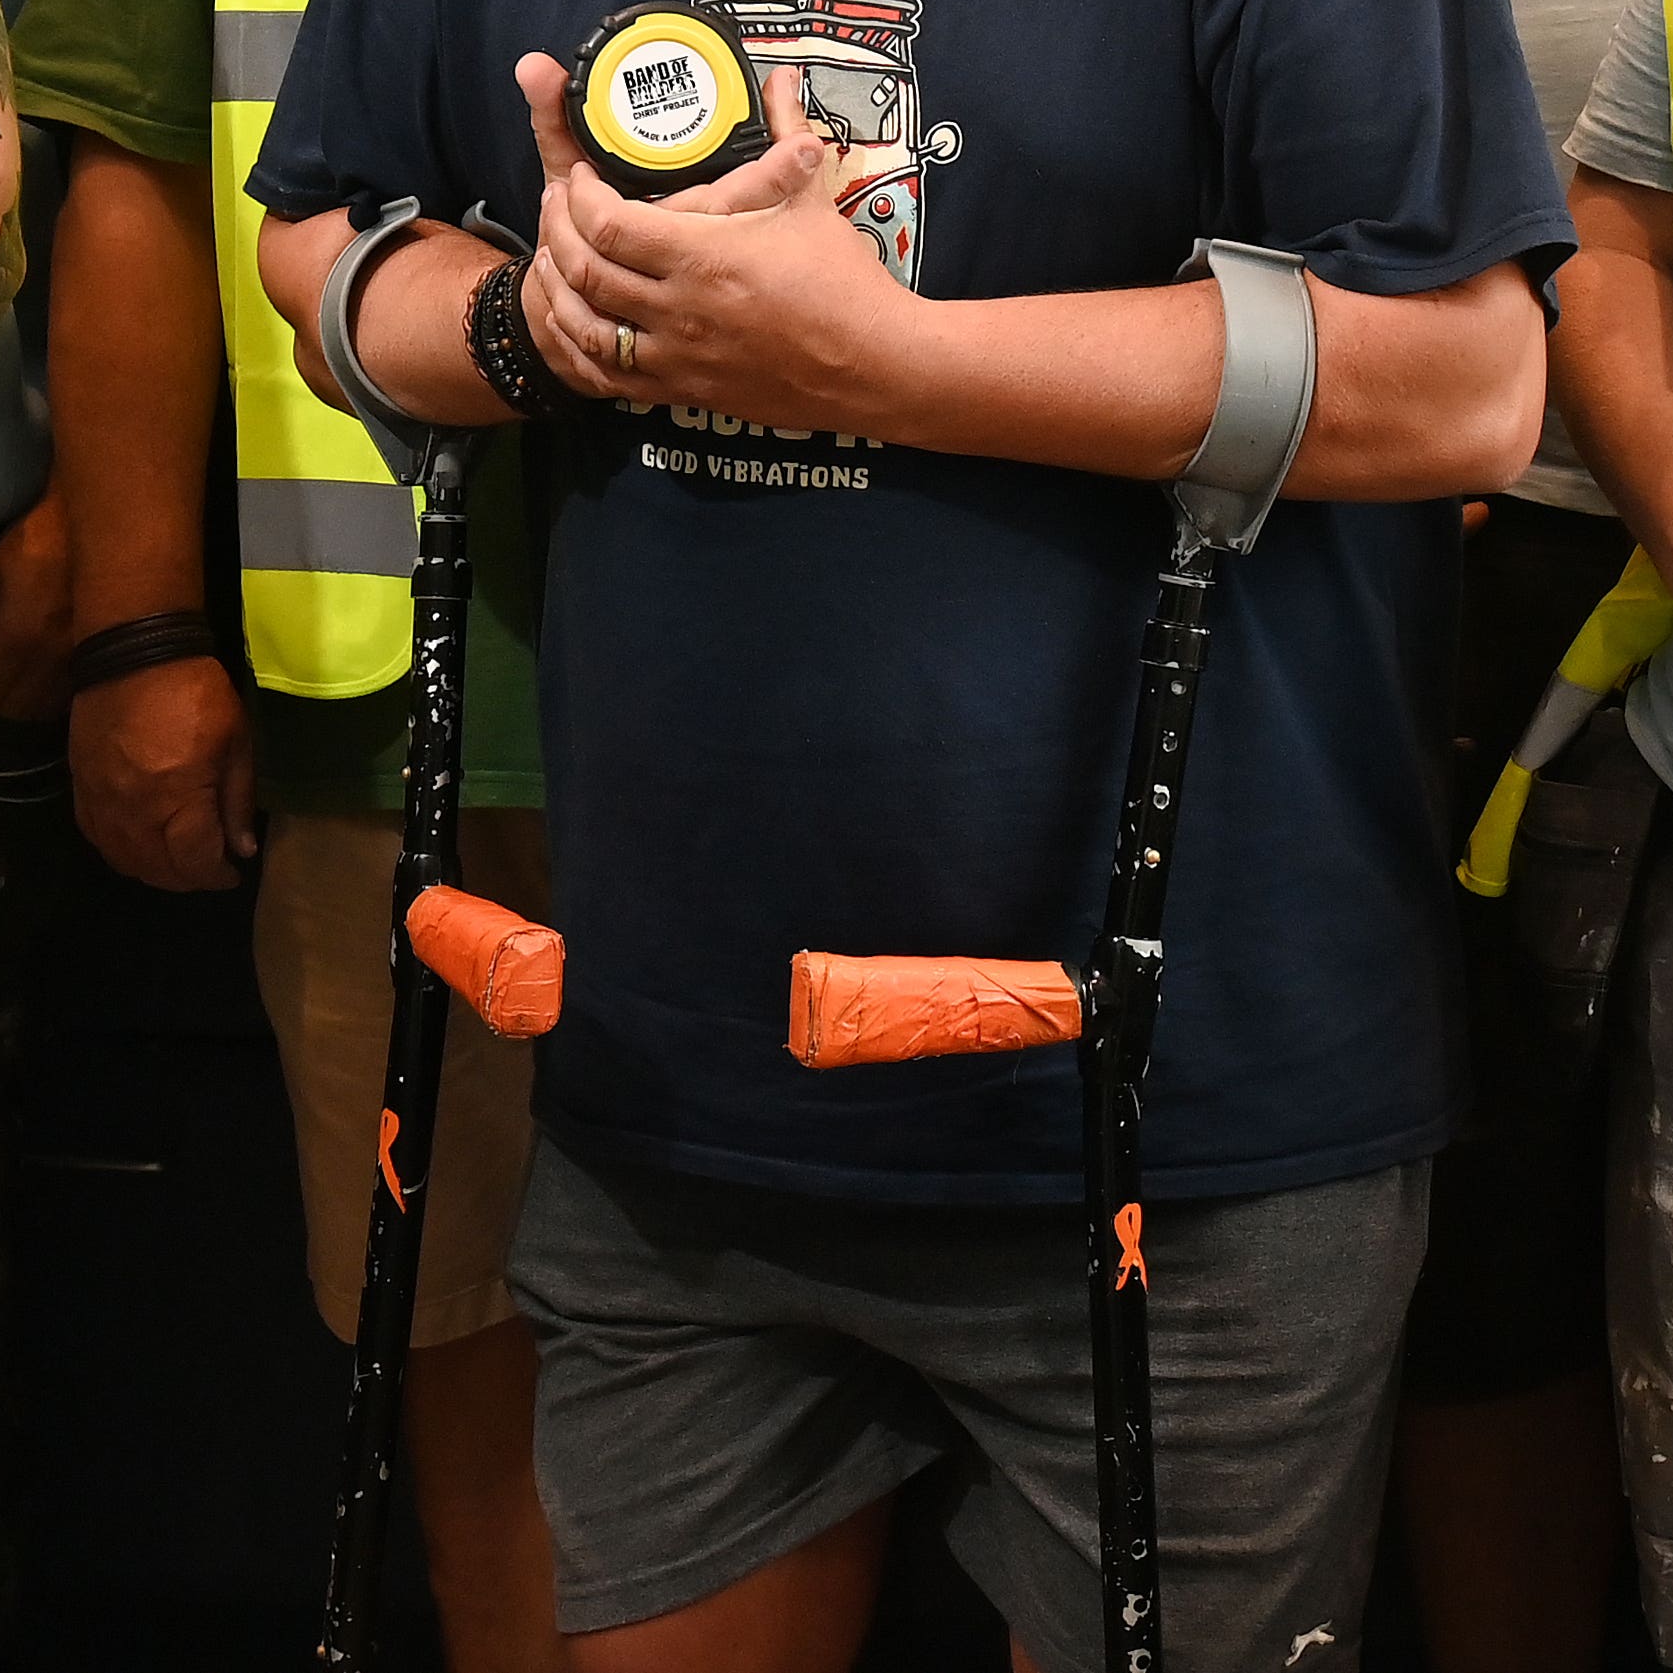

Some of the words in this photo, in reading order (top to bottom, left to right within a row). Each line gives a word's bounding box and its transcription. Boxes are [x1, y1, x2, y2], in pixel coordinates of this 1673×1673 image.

[622, 62, 670, 89] BAND
[671, 58, 688, 75] OF
[662, 96, 699, 112] PROJECT
[638, 129, 659, 141] MADE
[670, 107, 708, 141] DIFFERENCE
[641, 442, 698, 474] GOOD
